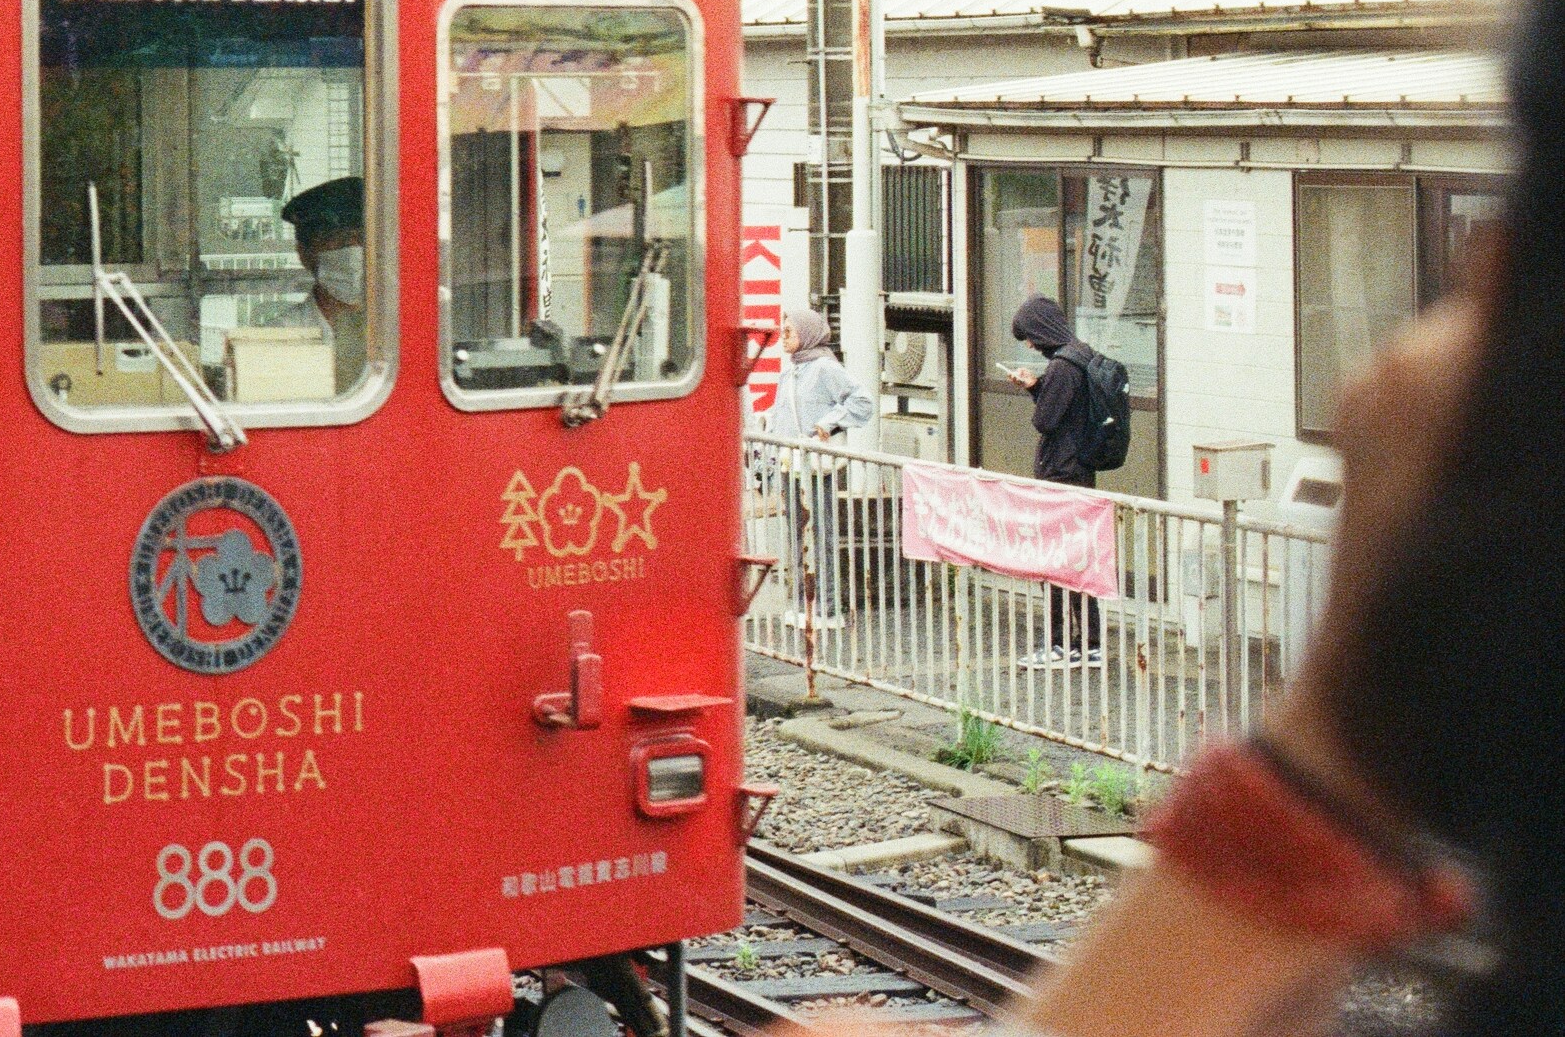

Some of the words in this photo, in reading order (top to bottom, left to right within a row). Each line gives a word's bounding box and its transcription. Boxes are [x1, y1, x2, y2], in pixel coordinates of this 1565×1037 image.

[527, 555, 645, 589] UMEBOSHI
[63, 691, 366, 751] UMEBOSHI
[102, 749, 328, 805] DENSHA
[153, 838, 278, 919] 888
